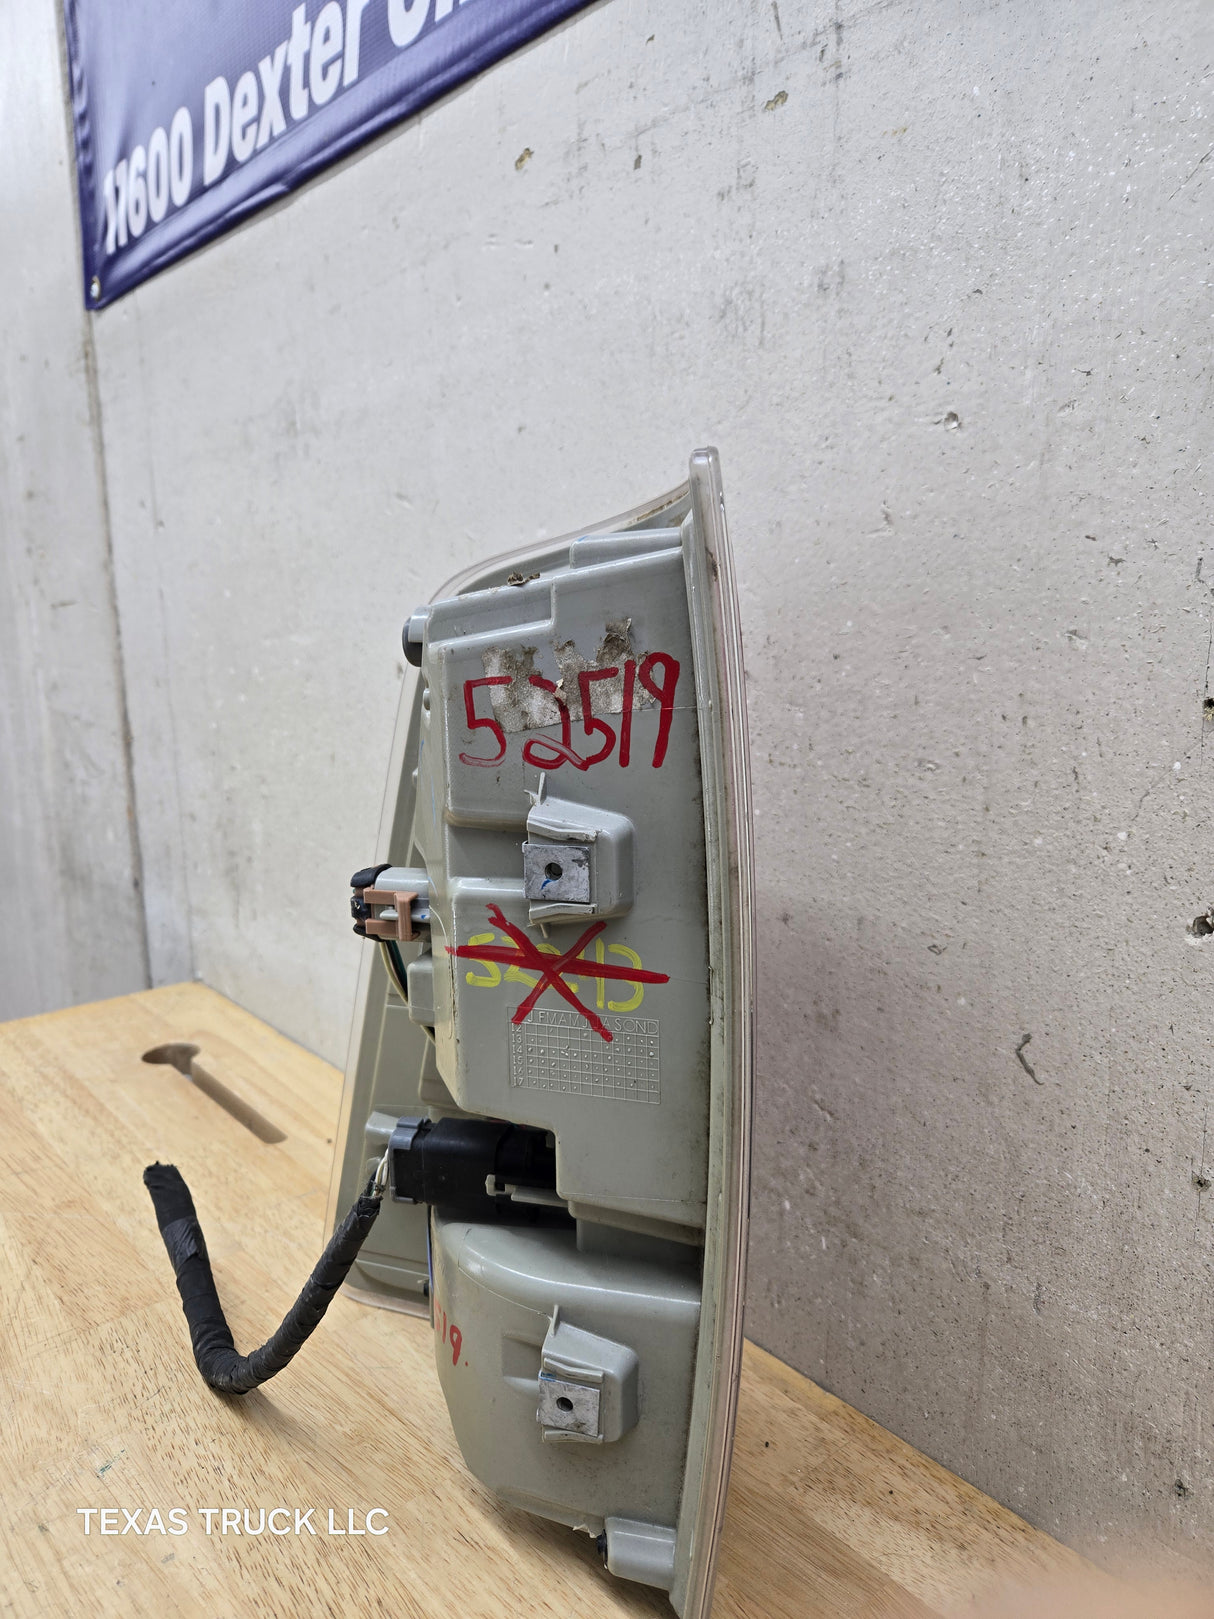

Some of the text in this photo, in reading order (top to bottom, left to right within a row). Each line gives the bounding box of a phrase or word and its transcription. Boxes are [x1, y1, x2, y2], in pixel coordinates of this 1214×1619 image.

[103, 0, 371, 255] 11600 Dexter
[458, 651, 681, 771] 52519
